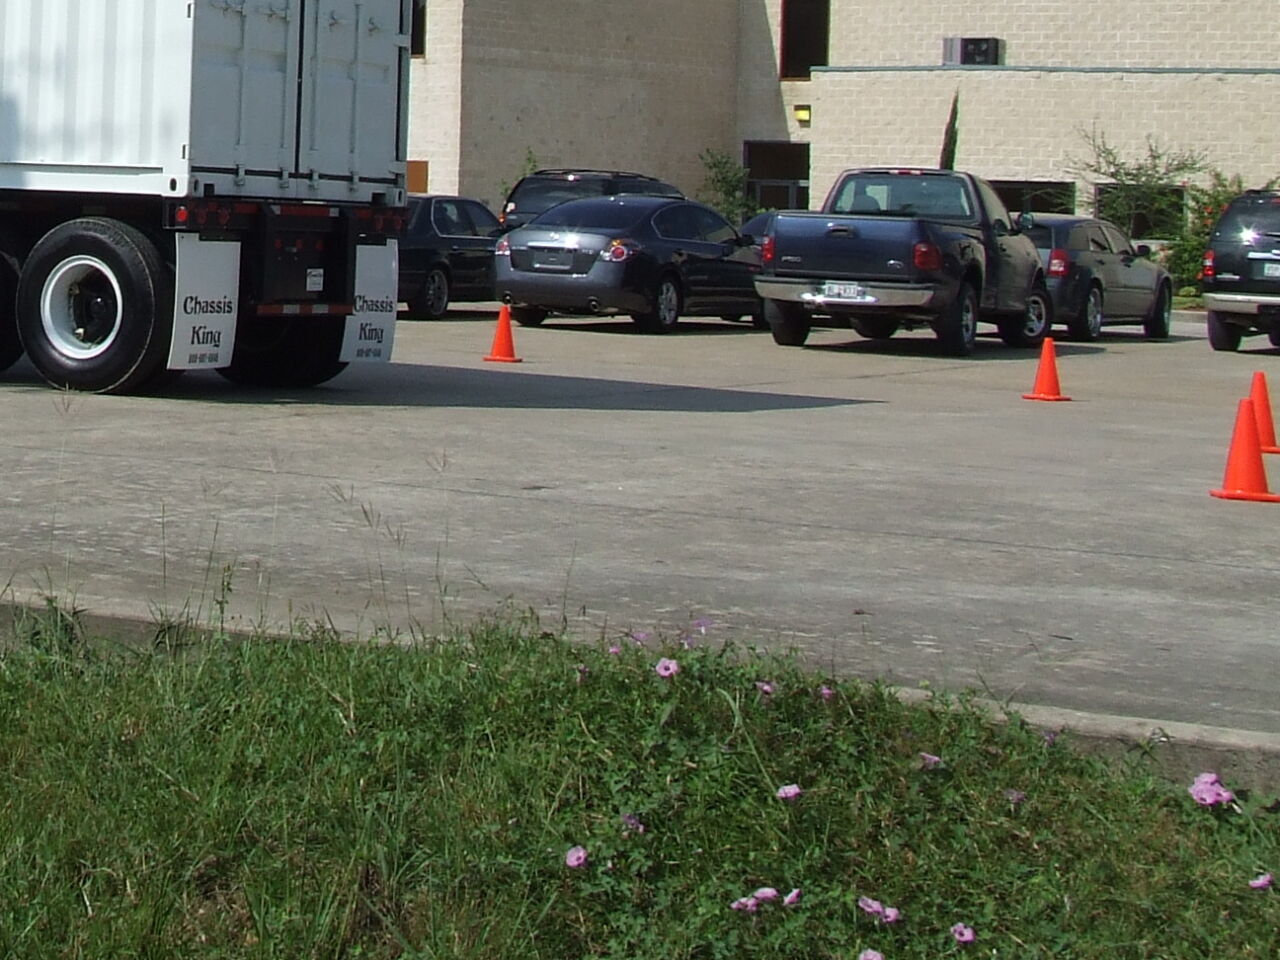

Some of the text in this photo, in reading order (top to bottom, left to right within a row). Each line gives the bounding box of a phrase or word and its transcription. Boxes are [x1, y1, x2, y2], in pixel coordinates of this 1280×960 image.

[183, 295, 233, 315] Chassis
[353, 294, 393, 313] Chassis
[191, 325, 221, 348] King
[359, 322, 384, 344] King
